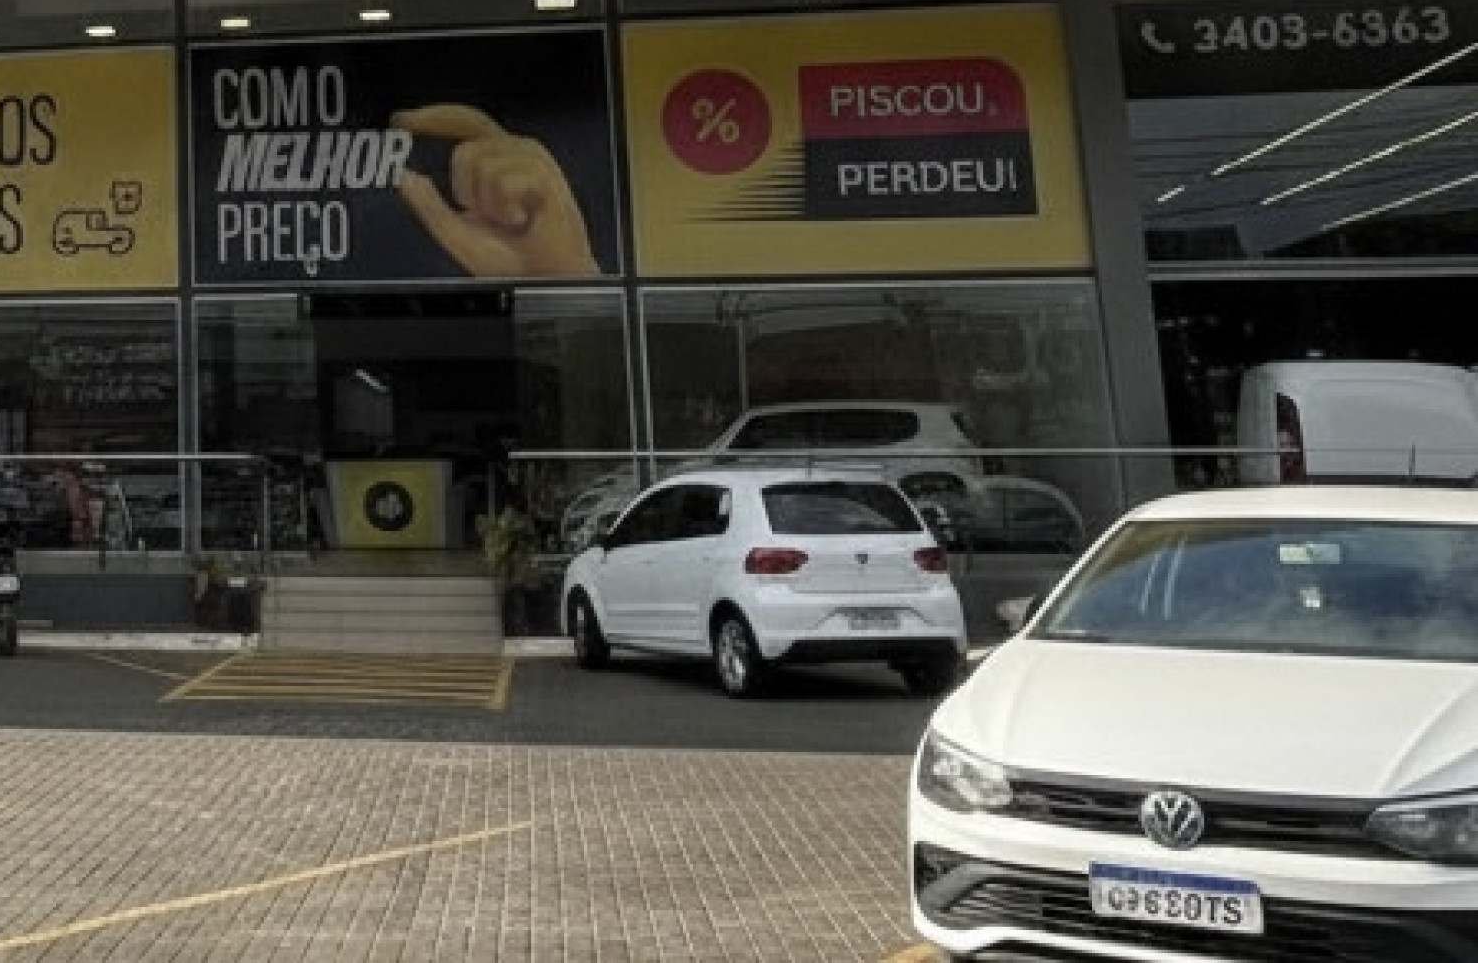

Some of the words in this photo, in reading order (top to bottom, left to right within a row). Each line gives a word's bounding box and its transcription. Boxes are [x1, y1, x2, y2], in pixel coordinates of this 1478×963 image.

[214, 67, 309, 129] COM
[317, 65, 345, 126] O
[216, 129, 413, 192] MELHOR
[217, 200, 349, 277] PREÇO
